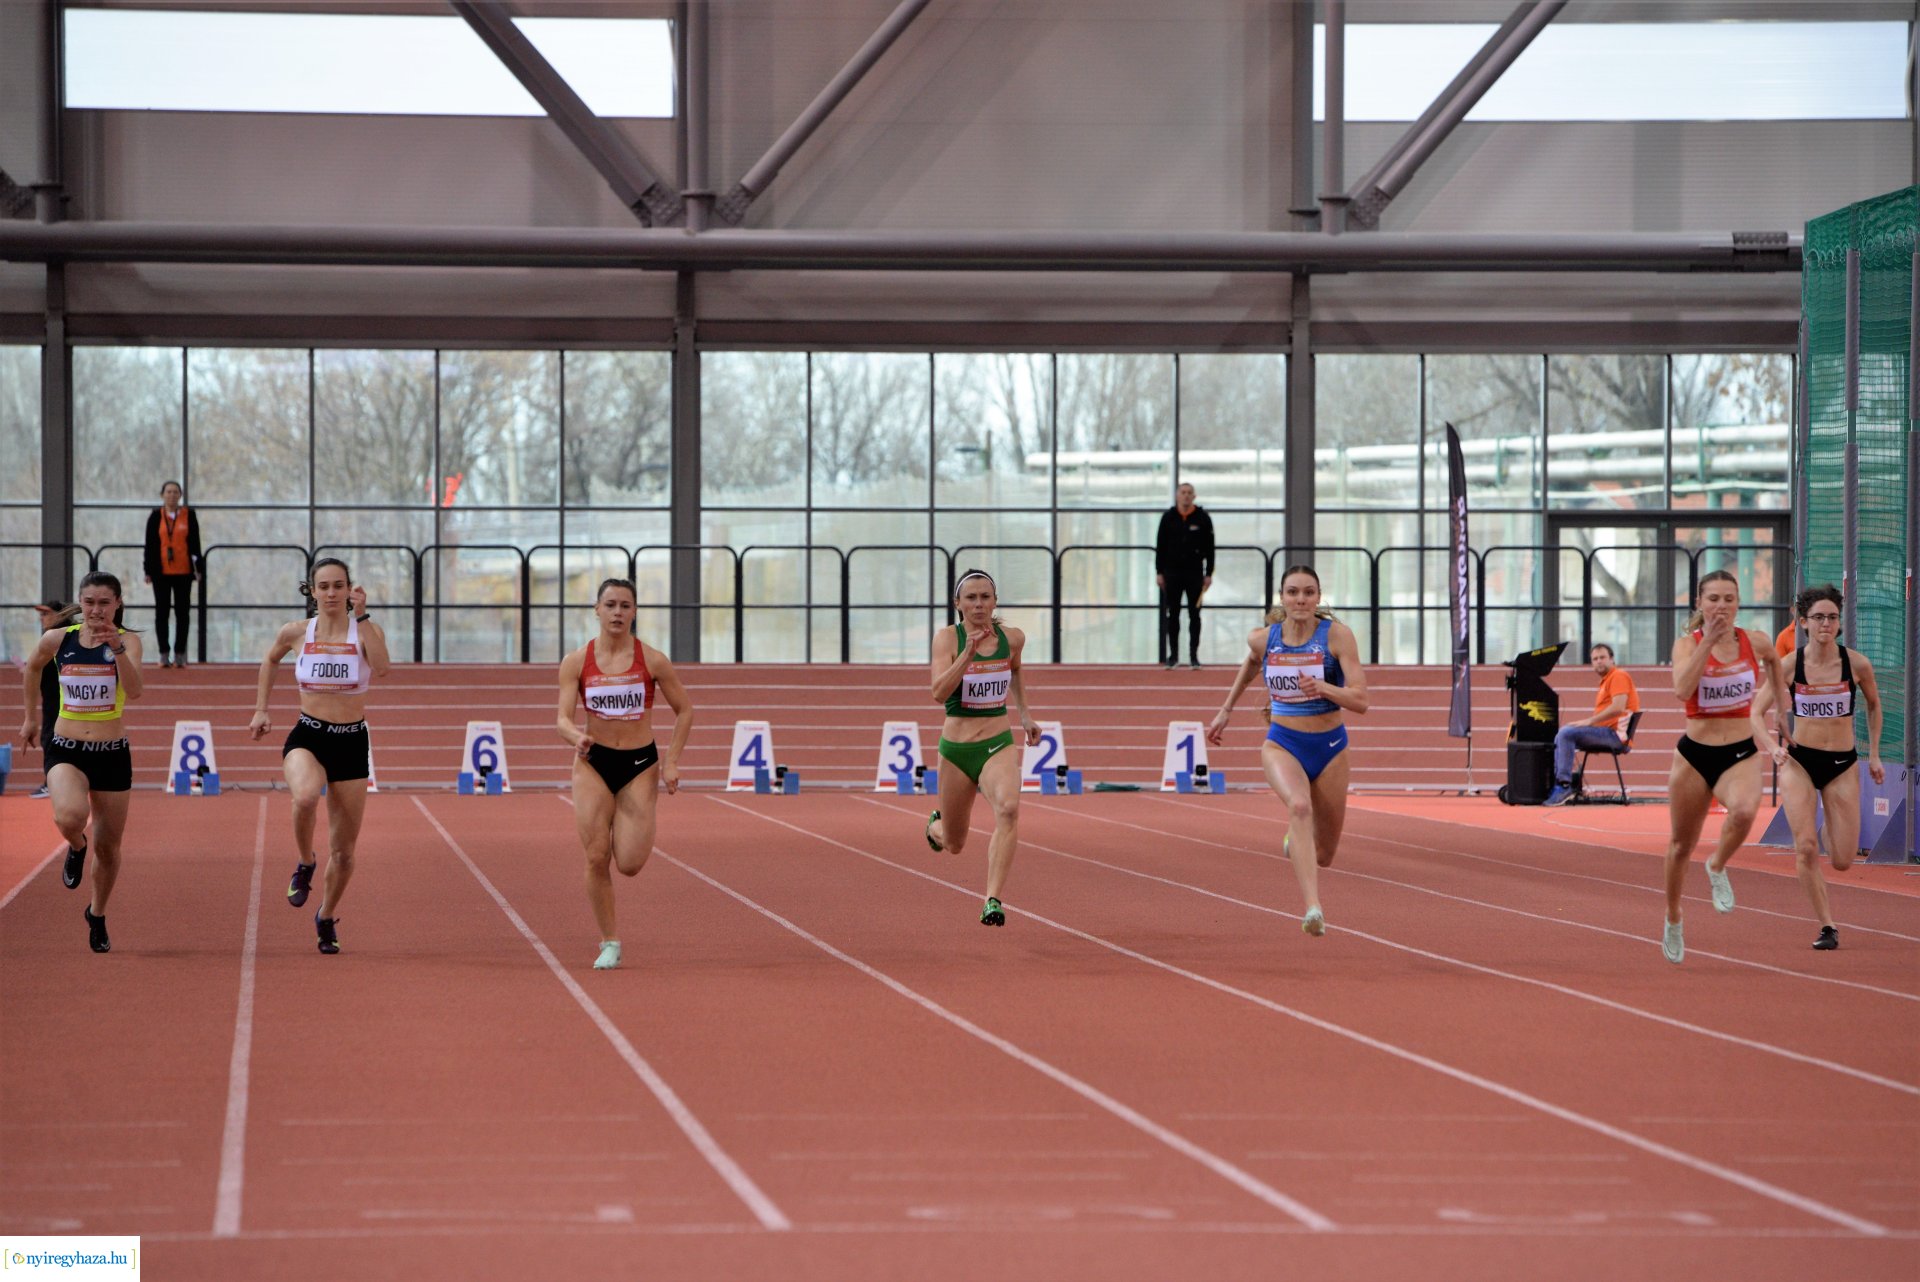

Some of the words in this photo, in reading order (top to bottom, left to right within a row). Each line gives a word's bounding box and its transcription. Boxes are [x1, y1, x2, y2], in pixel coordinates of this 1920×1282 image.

[312, 663, 349, 678] FODOR
[67, 685, 97, 700] NAGY
[100, 684, 109, 699] P.
[591, 691, 642, 709] SKRIVÁN
[1702, 683, 1743, 700] TAKÁCS
[1801, 702, 1833, 716] SIPOS
[300, 713, 322, 729] PRO
[327, 723, 360, 734] NIKE
[52, 735, 76, 749] PRO
[82, 739, 120, 752] NIKE
[180, 734, 206, 774] 8
[472, 734, 497, 774] 6
[738, 734, 767, 768] 4
[888, 734, 914, 774] 3
[1032, 734, 1057, 774] 2
[1177, 734, 1193, 774] 1
